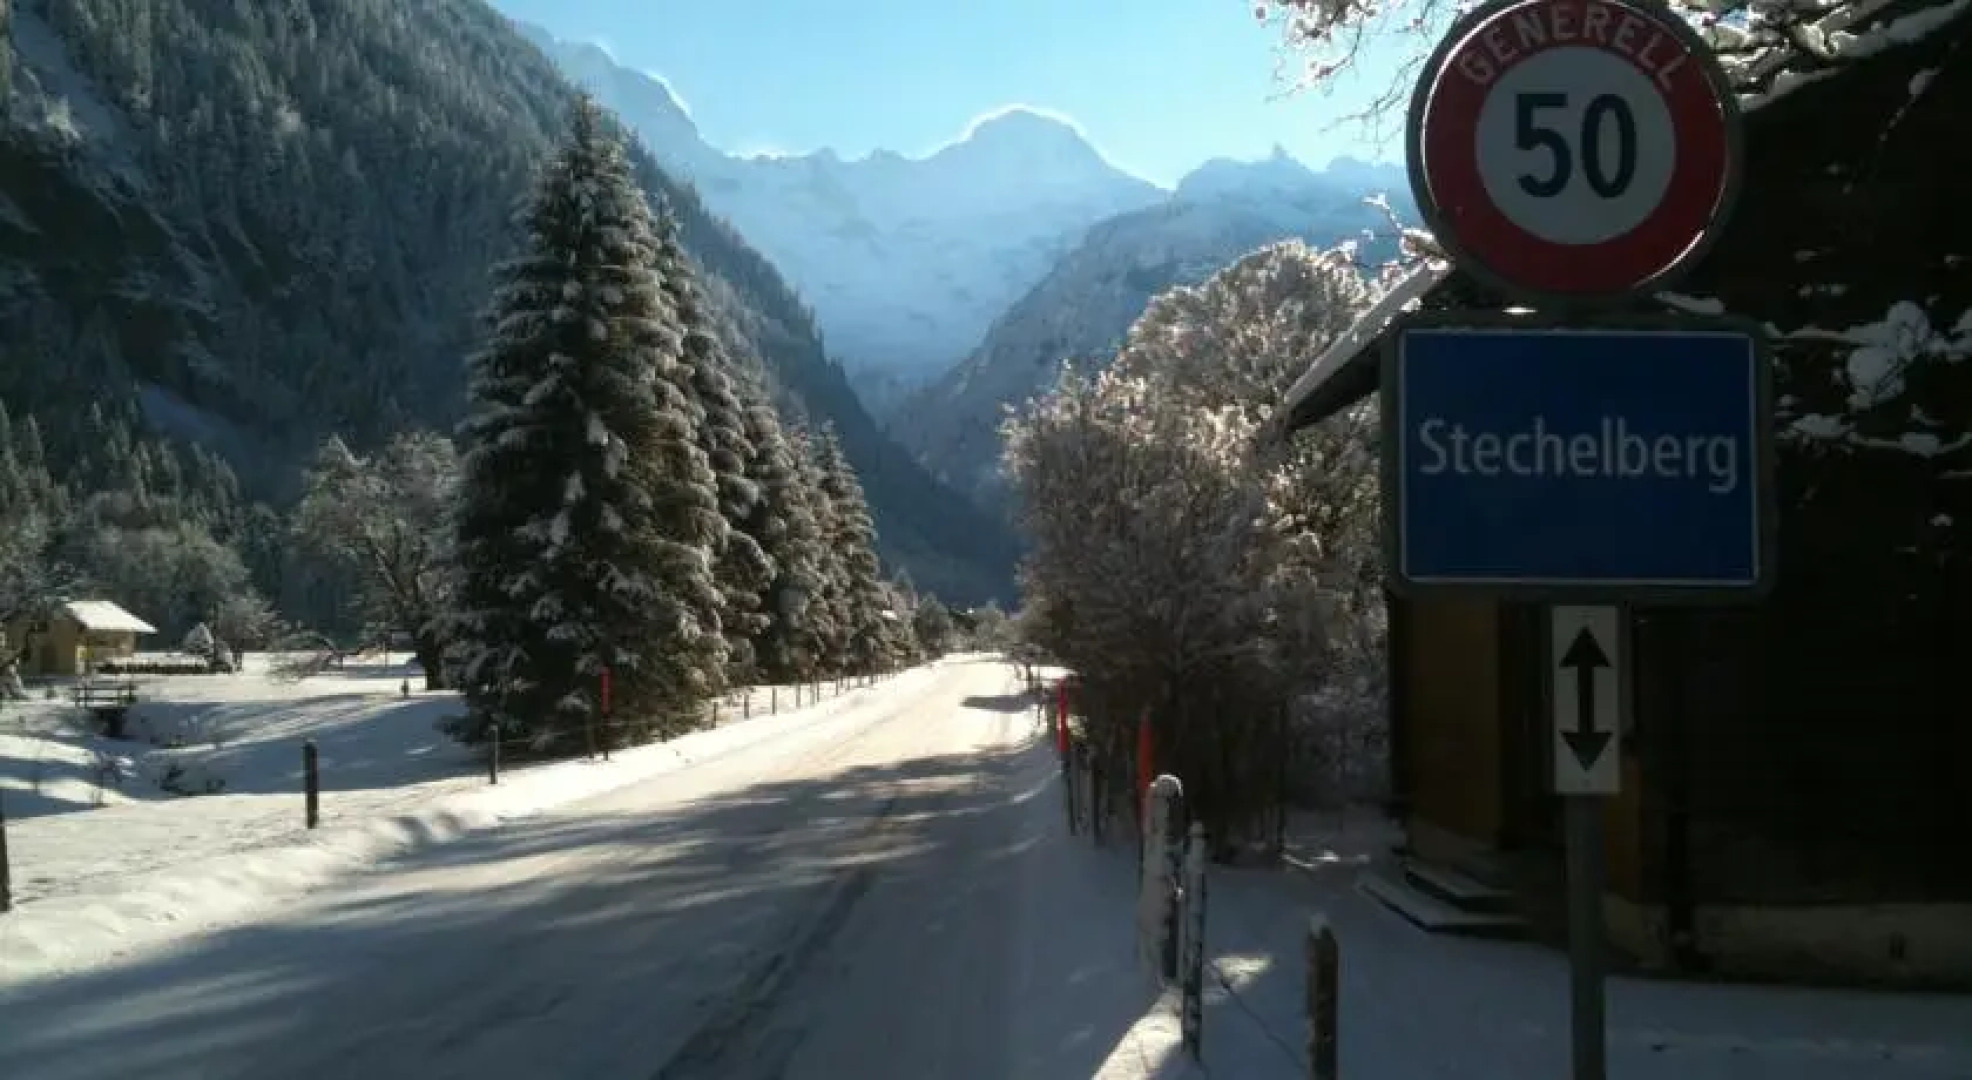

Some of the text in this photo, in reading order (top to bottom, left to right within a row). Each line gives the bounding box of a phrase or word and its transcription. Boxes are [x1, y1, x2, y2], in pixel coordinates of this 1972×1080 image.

[1459, 2, 1685, 89] GENERELL
[1515, 93, 1637, 198] 50
[1418, 414, 1738, 493] Stechelberg
